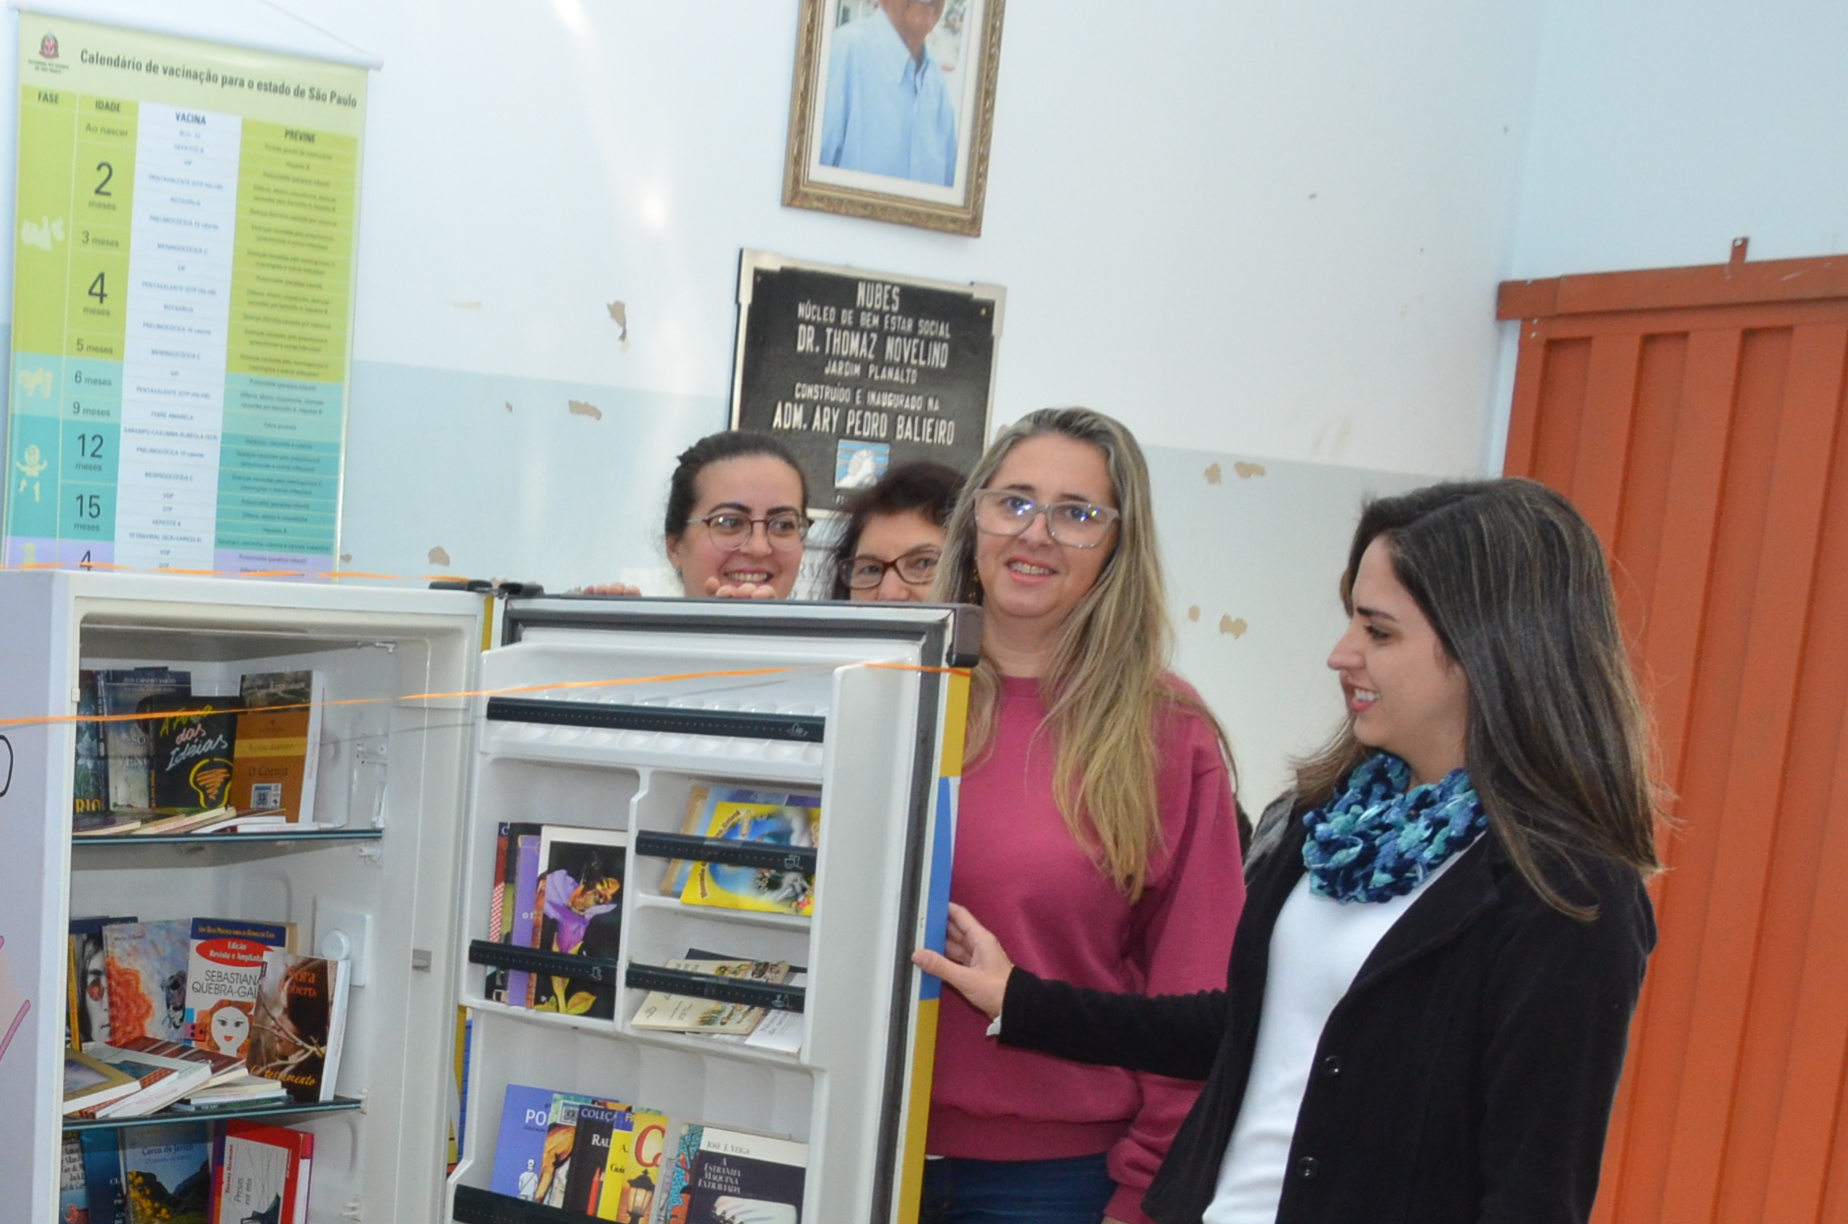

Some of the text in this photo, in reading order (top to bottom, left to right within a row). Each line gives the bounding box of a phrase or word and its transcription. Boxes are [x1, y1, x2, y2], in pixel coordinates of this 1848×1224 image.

[80, 48, 142, 72] Calendário
[145, 60, 159, 75] de
[162, 63, 219, 85] vacinação
[221, 74, 245, 88] para
[247, 79, 254, 89] o
[256, 79, 291, 96] estado
[293, 84, 305, 98] de
[308, 86, 327, 102] São
[329, 90, 357, 108] Paulo
[37, 91, 59, 105] FASE
[94, 100, 121, 113] IDADE
[175, 112, 207, 125] VACINA
[100, 124, 129, 138] nascer
[284, 129, 316, 143] PREVINE
[94, 161, 113, 197] 2
[88, 200, 116, 211] meses
[81, 230, 119, 248] 3 meses
[87, 272, 108, 305] 4
[856, 281, 900, 312] NUBES
[82, 306, 110, 317] meses
[797, 300, 951, 339] NÚCLEO DE BEM ESTAR SOCIAL
[76, 338, 113, 355] 5 meses
[797, 324, 949, 369] DR. THOMAZ NOVELINO
[74, 371, 112, 387] 6 meses
[824, 359, 918, 385] JARDIM PLANALTO
[794, 382, 940, 411] CONSTRUÍDO E INAUGURADO NA
[72, 401, 110, 418] 9 meses
[772, 401, 955, 446] ADM. ARY PEDRO BALIEIRO
[77, 433, 104, 458] 12
[75, 461, 102, 472] meses
[76, 493, 101, 519] 15
[73, 522, 100, 532] meses
[79, 550, 93, 572] 4
